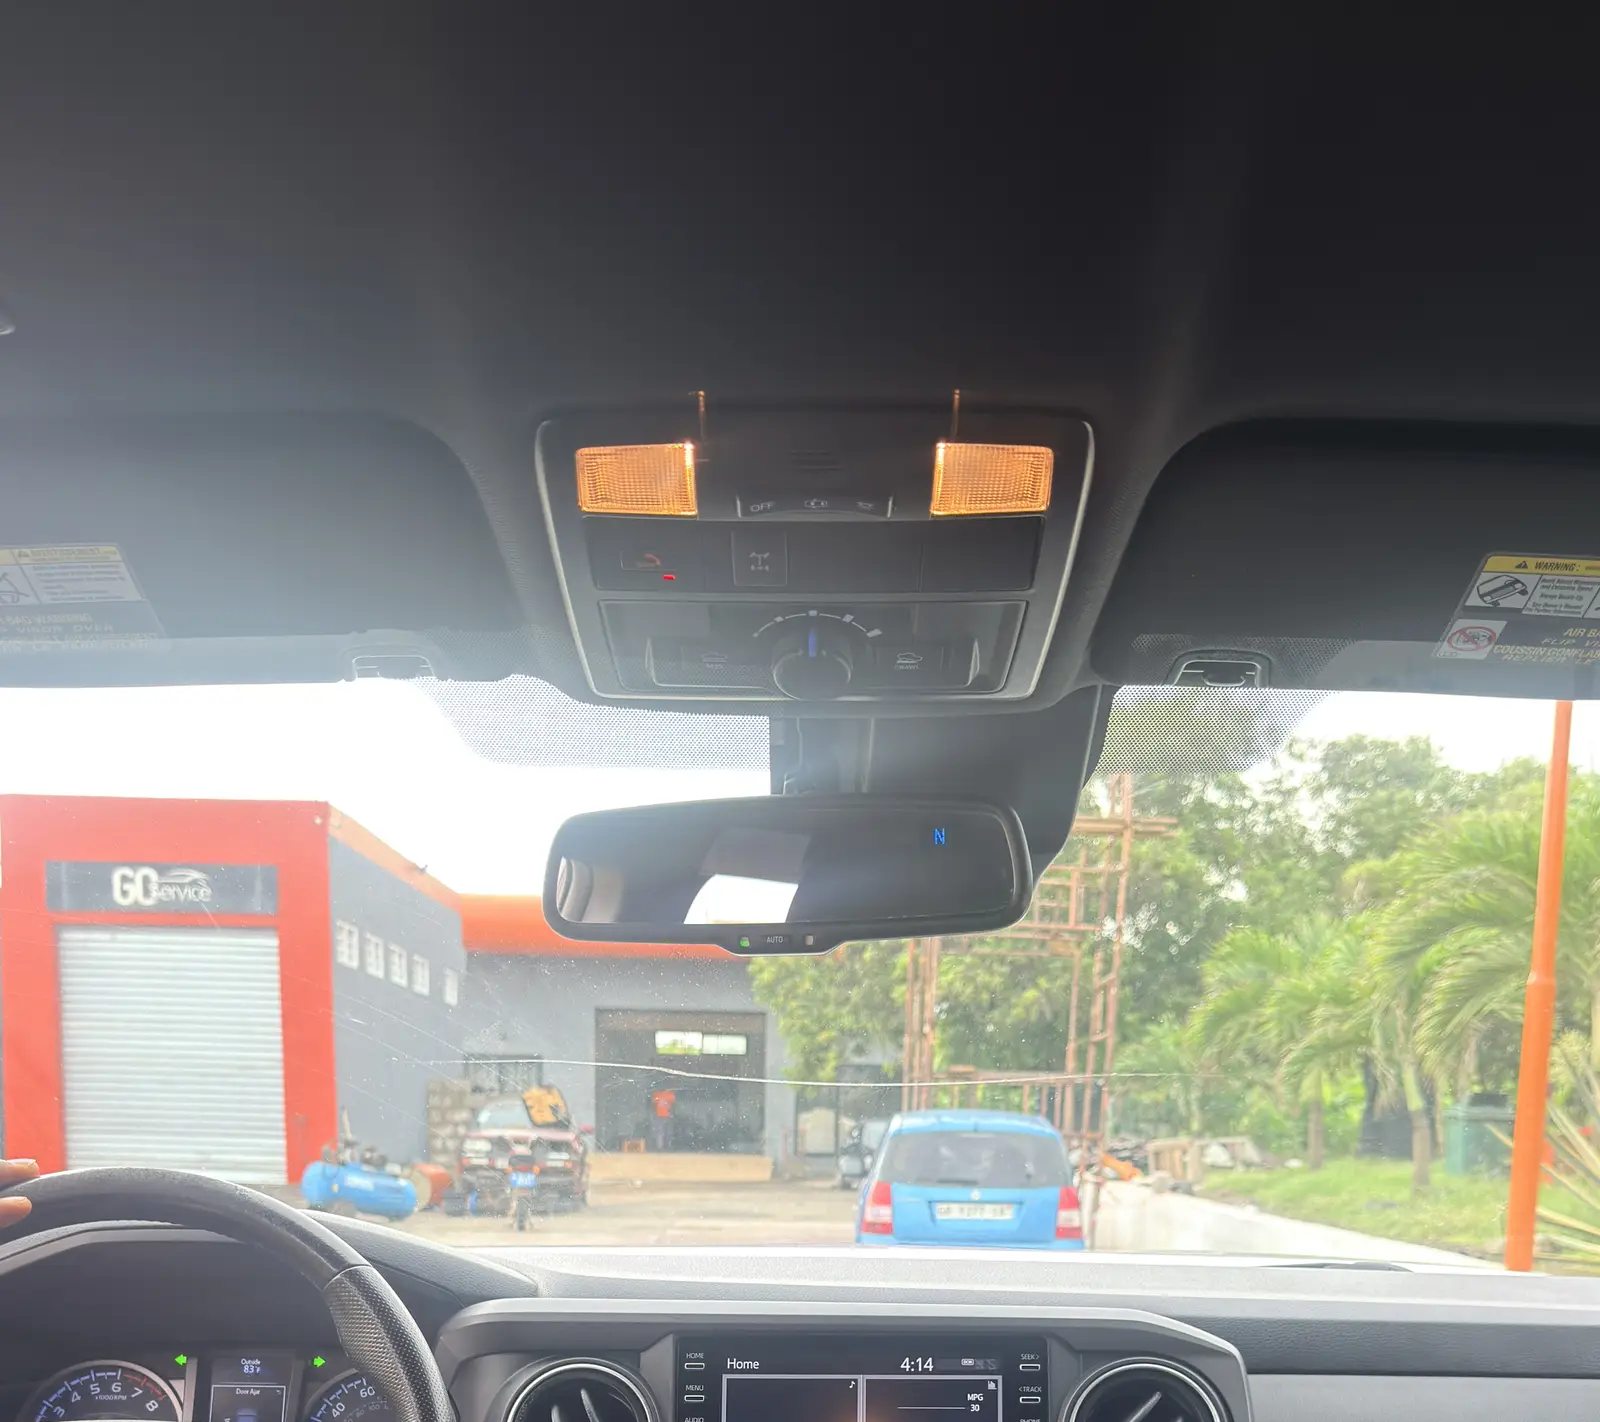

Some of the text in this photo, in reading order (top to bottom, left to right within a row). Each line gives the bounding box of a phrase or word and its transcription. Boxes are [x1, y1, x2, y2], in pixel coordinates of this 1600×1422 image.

[750, 501, 775, 512] OFF
[1563, 628, 1586, 637] AIR
[1493, 645, 1547, 655] COUSSIN
[934, 828, 945, 845] N
[112, 866, 158, 906] GO
[766, 936, 784, 944] AUTO
[727, 1358, 760, 1369] Home
[900, 1357, 934, 1372] 4:14
[90, 1383, 100, 1395] 5
[111, 1382, 122, 1393] 6
[131, 1387, 143, 1398] 7
[360, 1386, 376, 1398] 60
[71, 1392, 81, 1403] 4
[967, 1393, 984, 1401] MPG
[145, 1400, 159, 1412] 8
[332, 1402, 346, 1418] 40
[970, 1404, 980, 1412] 30
[53, 1406, 65, 1418] 3
